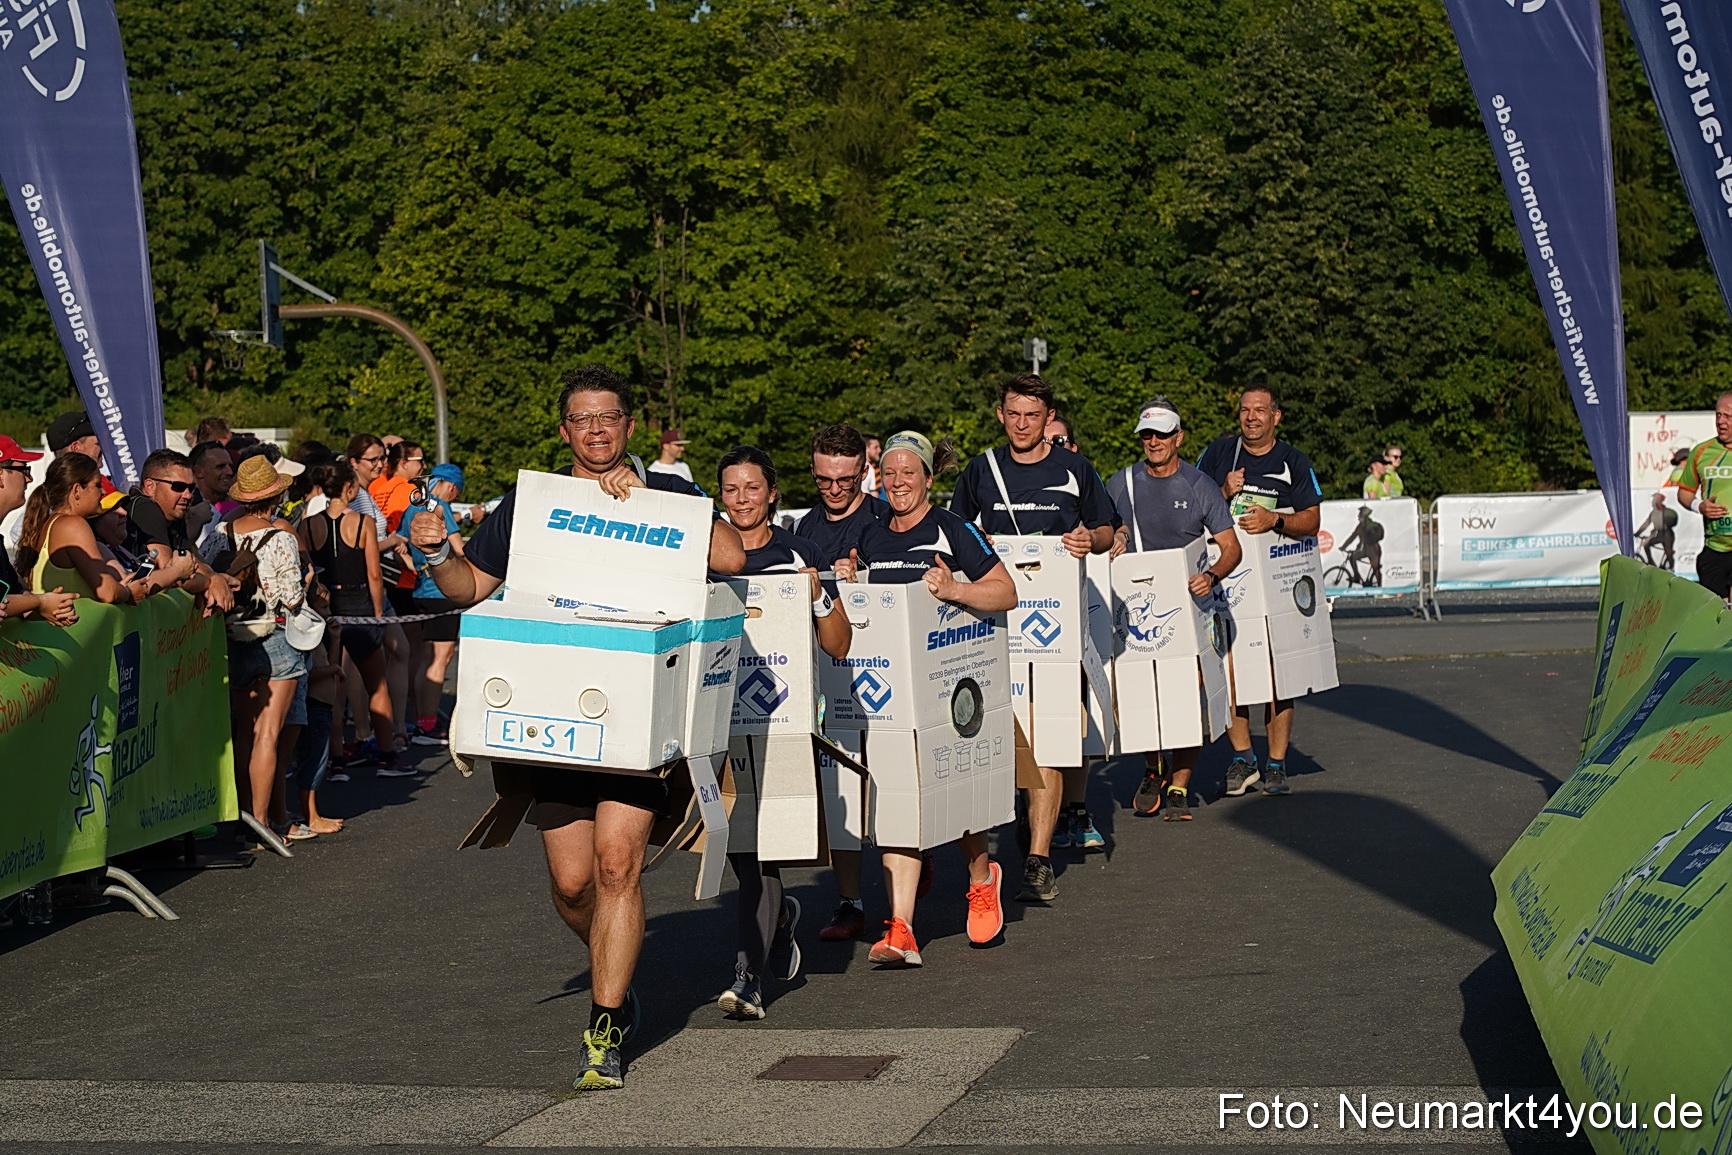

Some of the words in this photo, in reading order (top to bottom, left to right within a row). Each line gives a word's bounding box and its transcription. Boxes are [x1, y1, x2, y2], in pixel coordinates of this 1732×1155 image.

[547, 508, 684, 549] Schmidt
[1462, 517, 1496, 529] NOW
[1270, 538, 1313, 559] Schmidt
[1464, 538, 1512, 551] E-BIKES
[1516, 538, 1525, 548] &
[1528, 532, 1608, 548] FAHRRÄDER
[927, 616, 995, 651] Schmidt
[738, 652, 788, 667] nsratio
[832, 656, 890, 668] transratio
[928, 672, 944, 681] 92339
[972, 658, 998, 670] Oberbayern
[702, 669, 732, 688] Schmidt
[943, 679, 951, 688] Tel.
[1012, 682, 1024, 696] IV
[742, 717, 780, 726] Möbelspediteure
[820, 752, 837, 768] Gr.
[700, 786, 712, 804] Gr.
[712, 783, 720, 801] IV
